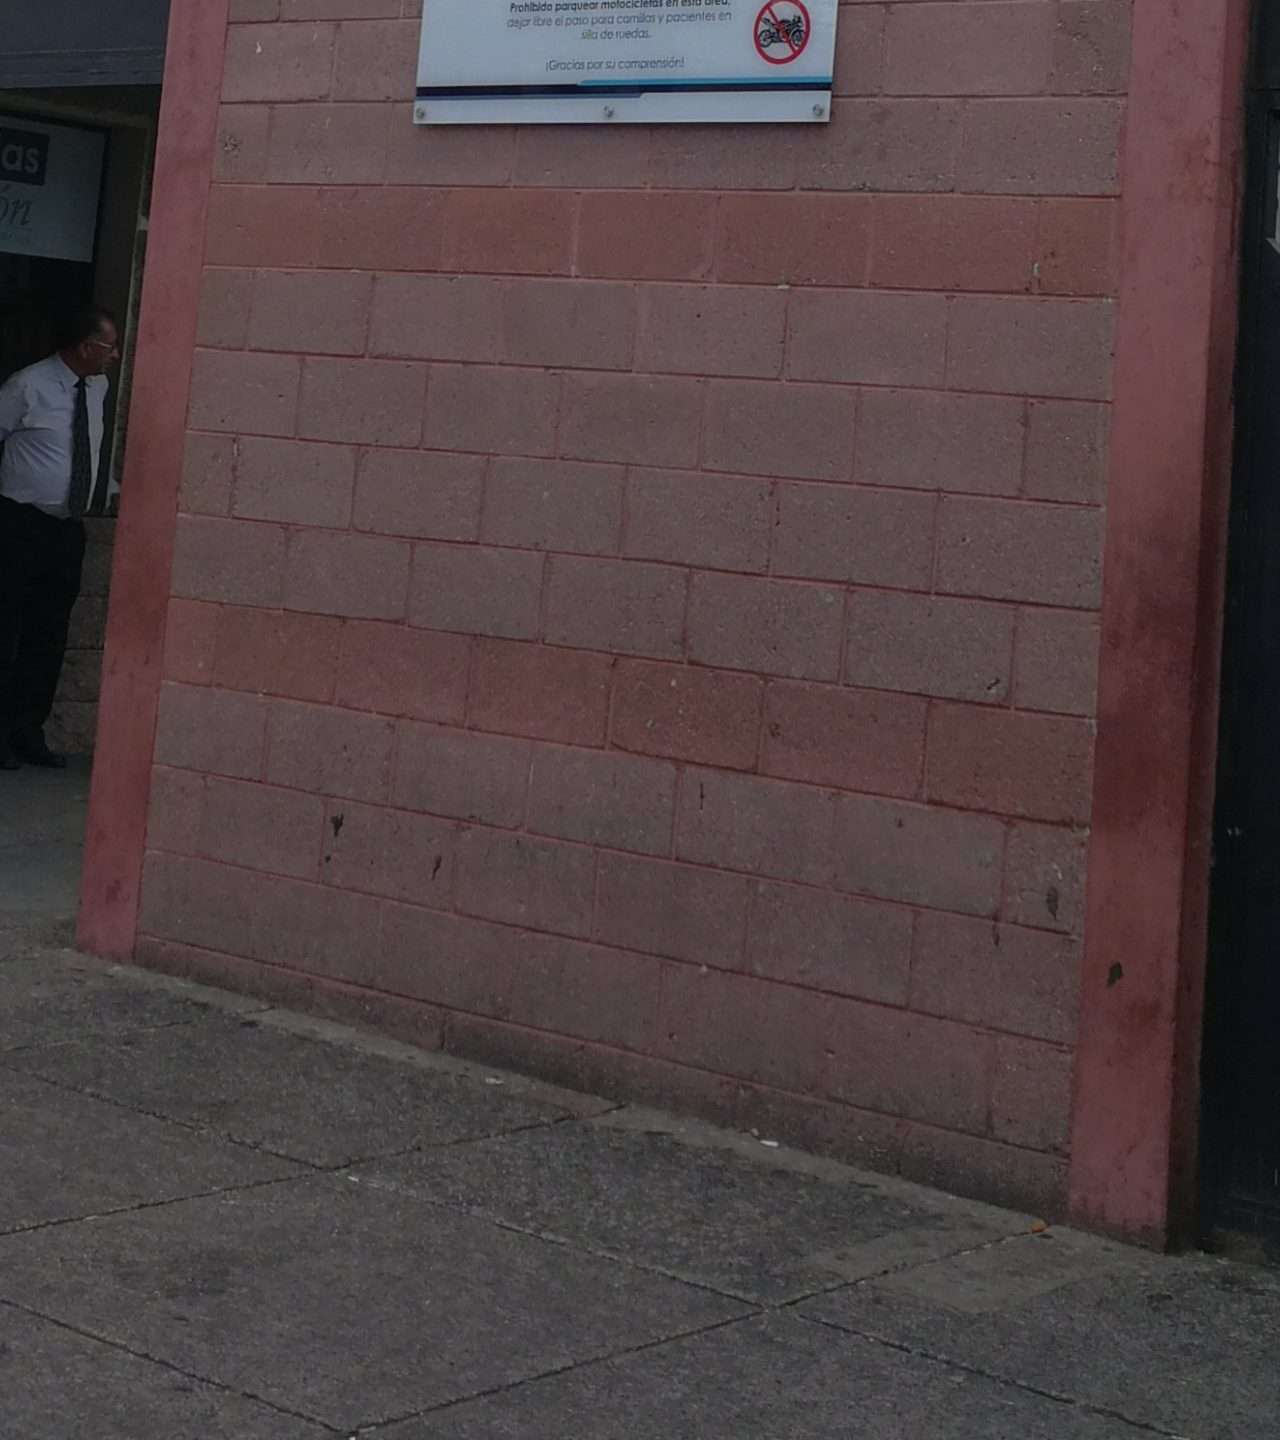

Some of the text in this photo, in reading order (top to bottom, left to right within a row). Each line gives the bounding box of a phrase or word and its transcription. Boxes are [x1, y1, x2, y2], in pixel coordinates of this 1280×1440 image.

[510, 1, 553, 13] Prohibido
[555, 0, 599, 13] parquear
[666, 0, 679, 8] en
